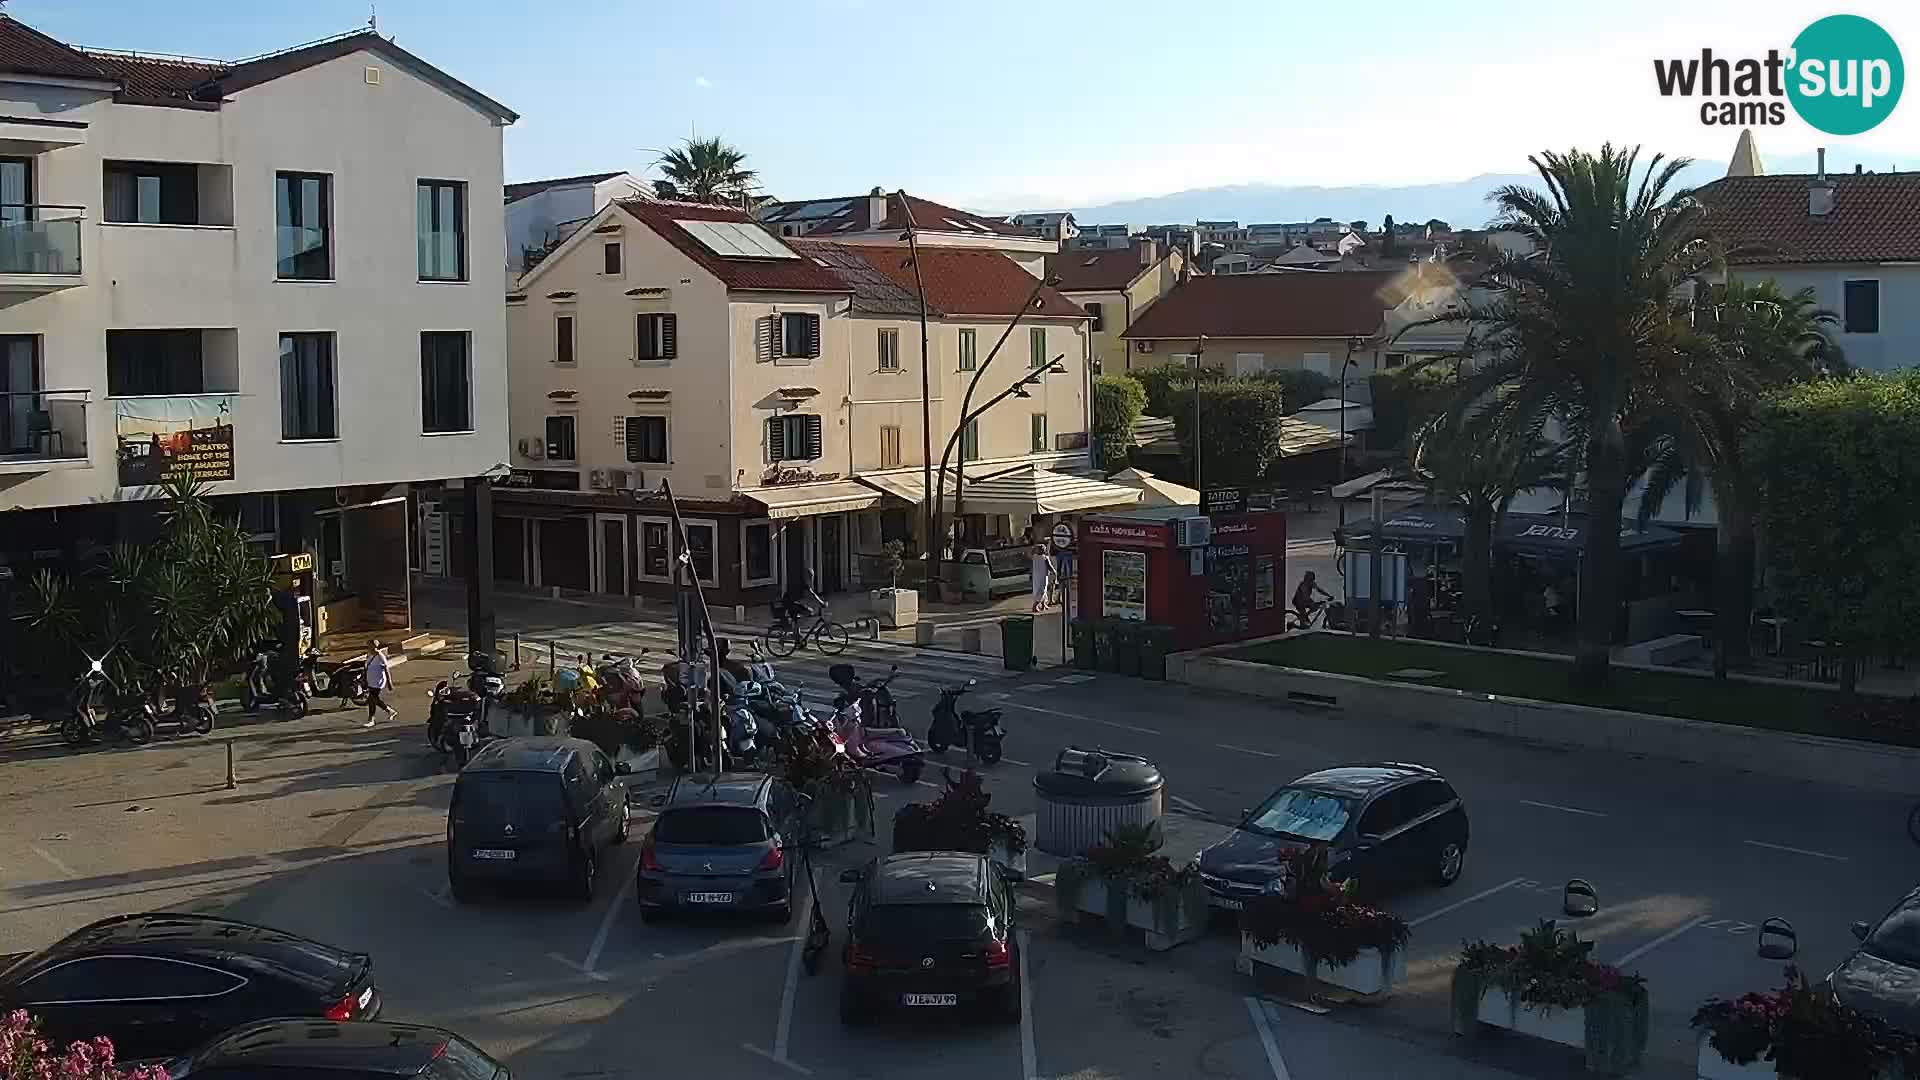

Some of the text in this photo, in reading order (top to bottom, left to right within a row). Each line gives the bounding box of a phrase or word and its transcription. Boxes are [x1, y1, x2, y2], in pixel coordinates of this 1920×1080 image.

[215, 451, 230, 459] THE
[194, 460, 230, 469] AMAZING
[293, 556, 311, 569] ATM
